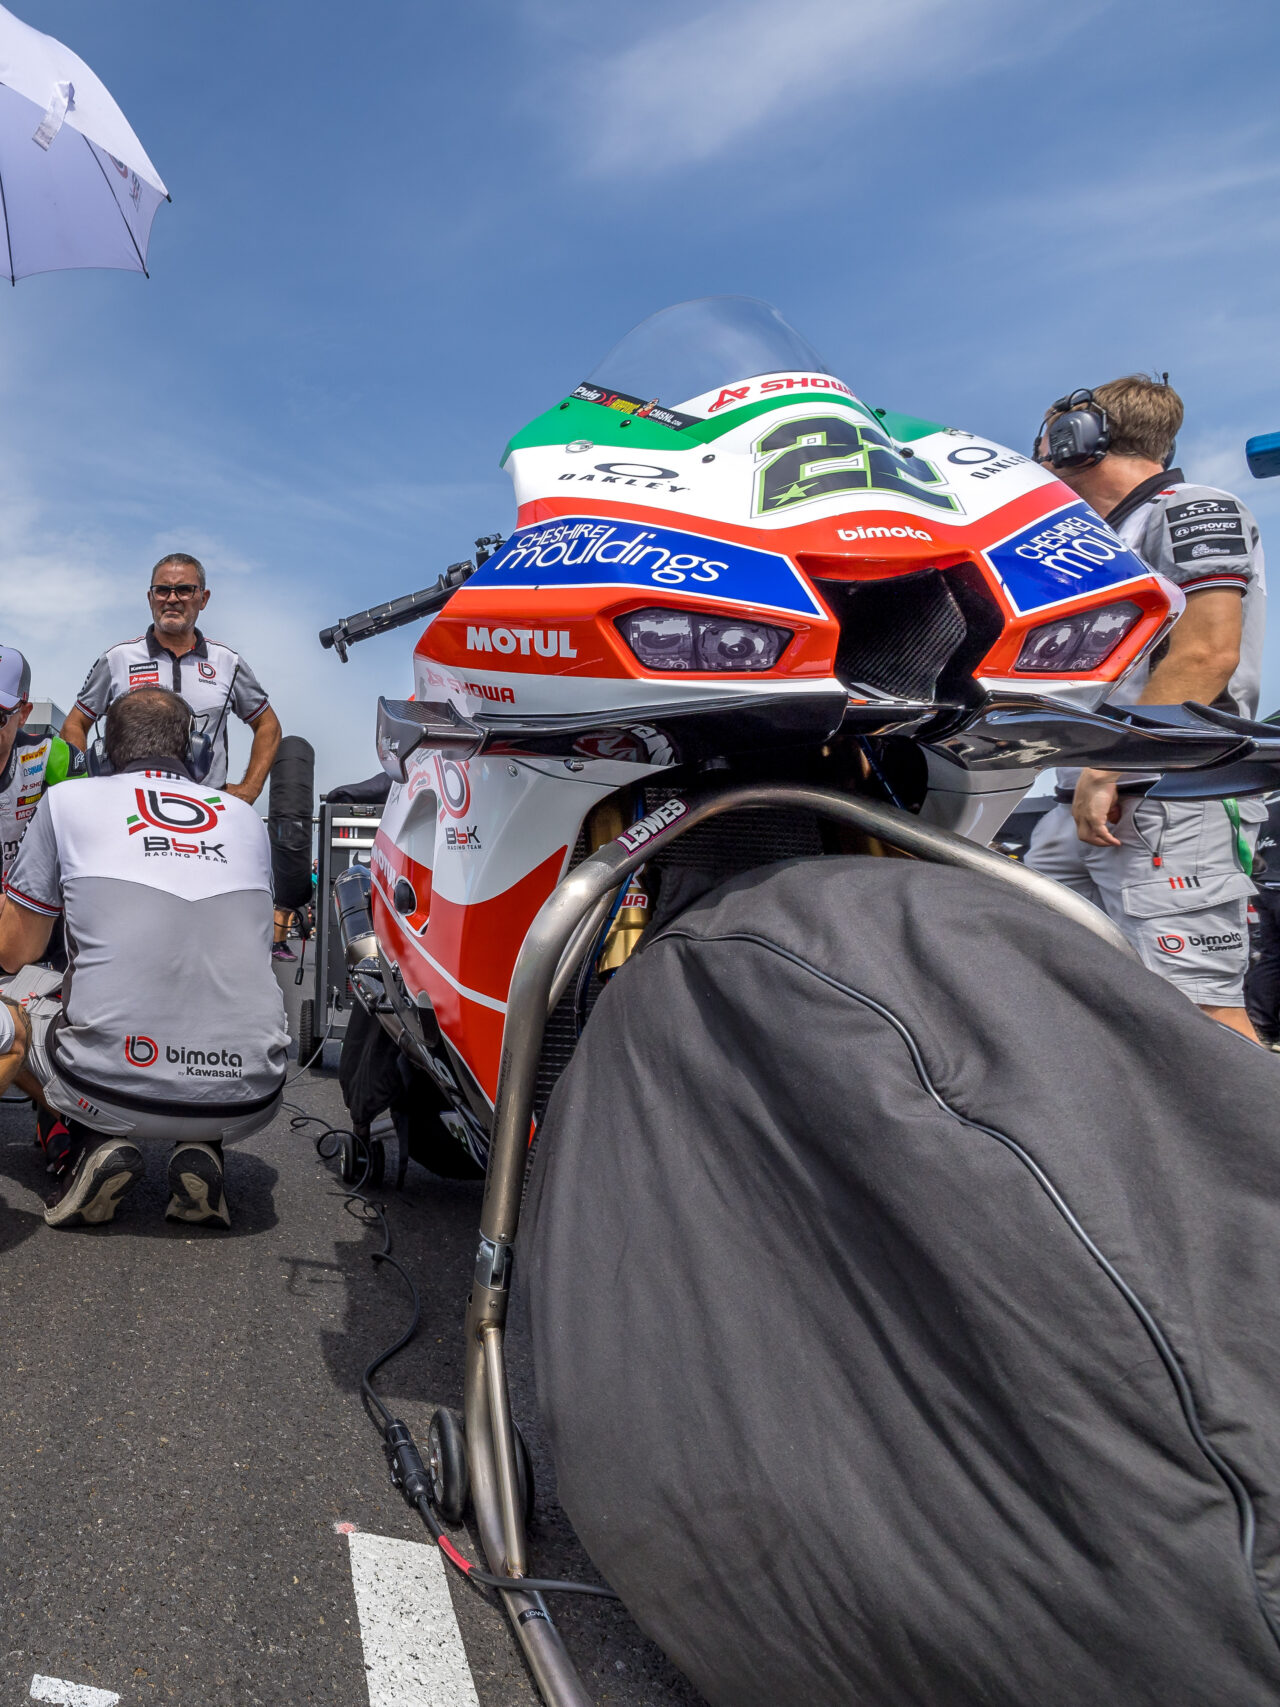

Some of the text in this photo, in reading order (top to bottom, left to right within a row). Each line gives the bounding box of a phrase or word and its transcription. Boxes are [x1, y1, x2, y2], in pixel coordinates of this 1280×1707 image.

[574, 386, 601, 400] Puig
[760, 378, 858, 398] SHOW
[558, 473, 686, 492] OAKLEY
[1180, 507, 1227, 518] OAKLEY
[517, 523, 610, 549] CHESHIRE
[837, 525, 933, 542] bimota
[1190, 521, 1237, 532] PROVEC
[494, 527, 730, 584] mouldings
[467, 627, 577, 658] MOTUL
[448, 679, 515, 704] SHOWA
[617, 799, 686, 851] LOWES
[197, 855, 228, 864] TEAM
[166, 1046, 242, 1067] bimota
[186, 1067, 242, 1078] Kawasaki
